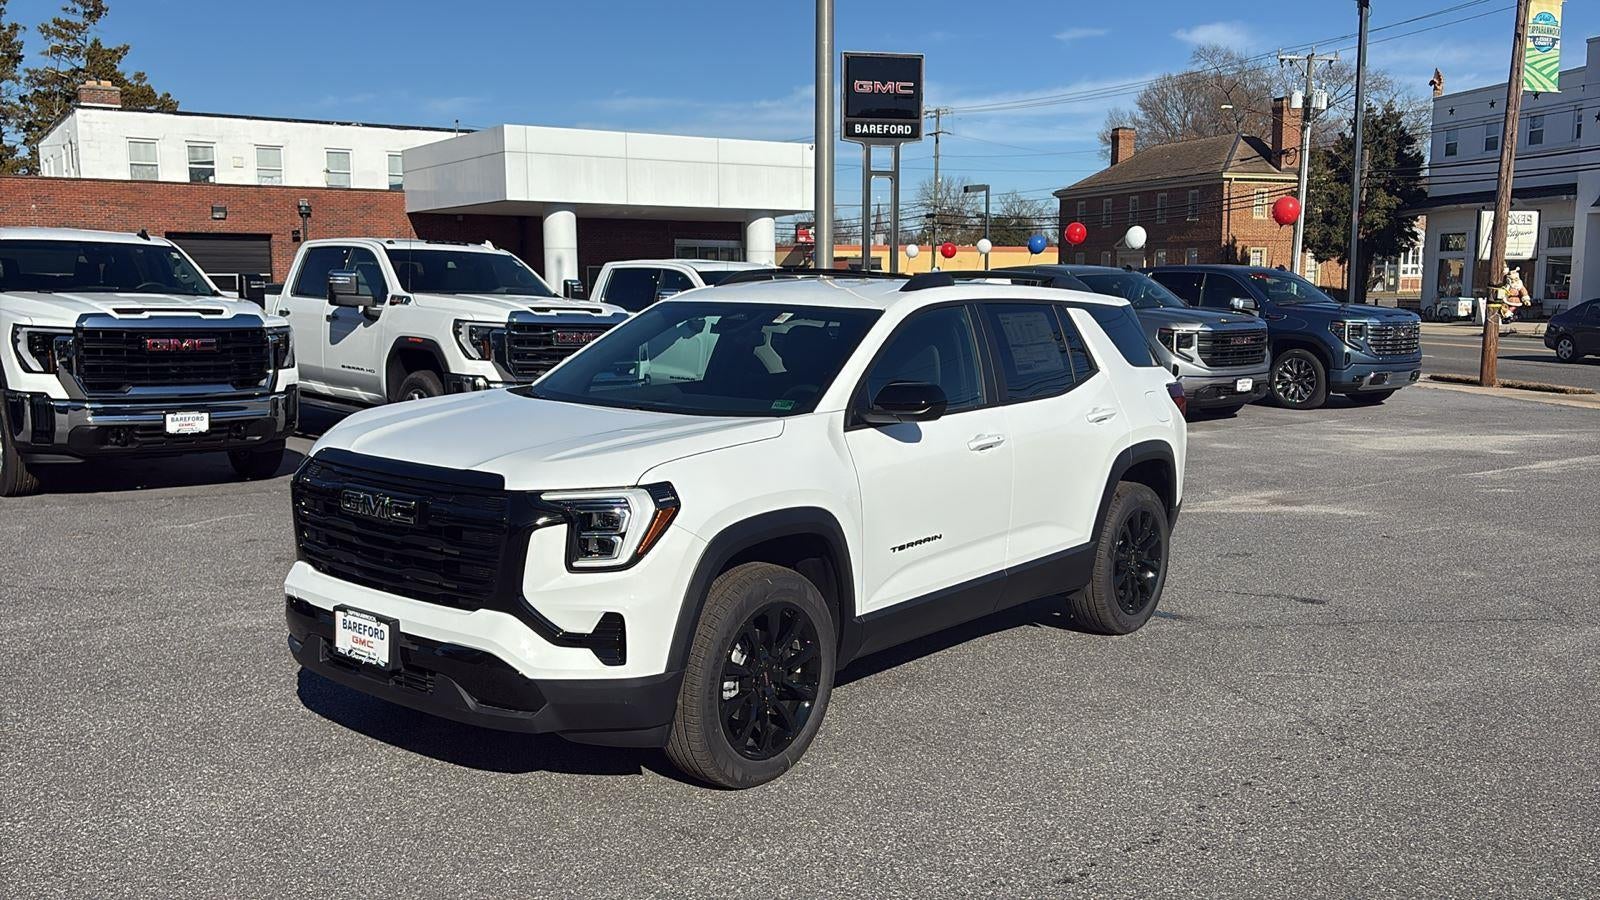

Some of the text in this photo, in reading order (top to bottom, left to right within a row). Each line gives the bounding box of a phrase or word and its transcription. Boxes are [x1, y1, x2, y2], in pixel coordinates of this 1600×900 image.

[854, 80, 914, 94] GMC
[854, 124, 912, 134] BAREFORD
[146, 338, 217, 351] GMC
[341, 490, 416, 525] GMC
[890, 534, 943, 553] TERRAIN
[342, 618, 386, 641] BAREFORD
[351, 635, 375, 649] GMC
